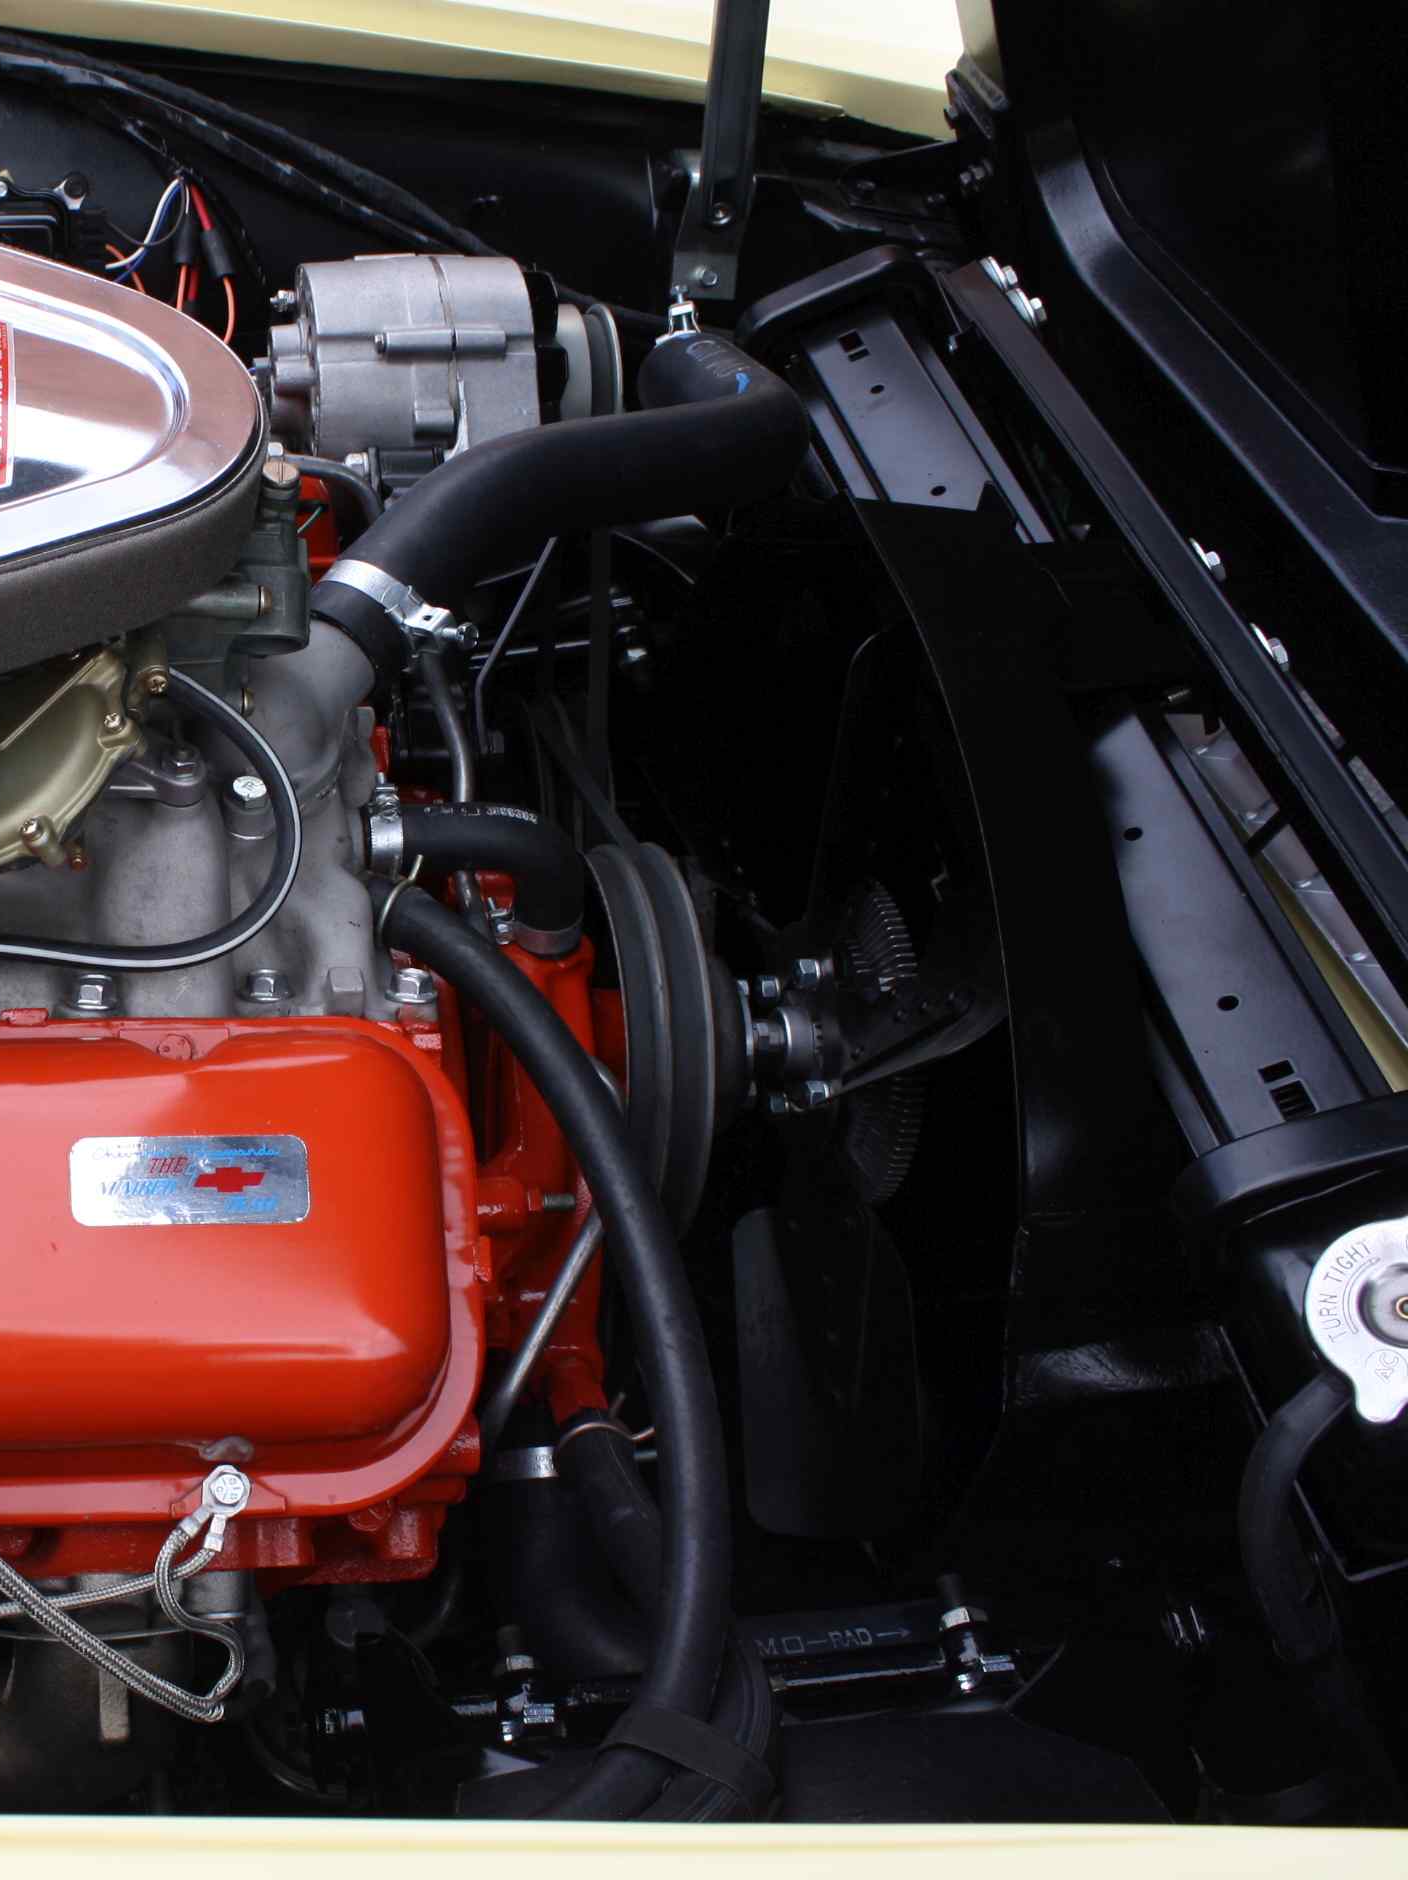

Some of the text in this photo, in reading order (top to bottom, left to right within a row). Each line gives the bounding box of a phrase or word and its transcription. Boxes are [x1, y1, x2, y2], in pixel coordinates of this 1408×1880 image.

[147, 1155, 189, 1177] THE
[1318, 1240, 1373, 1345] TURN TIGHT
[1374, 1350, 1400, 1384] AC
